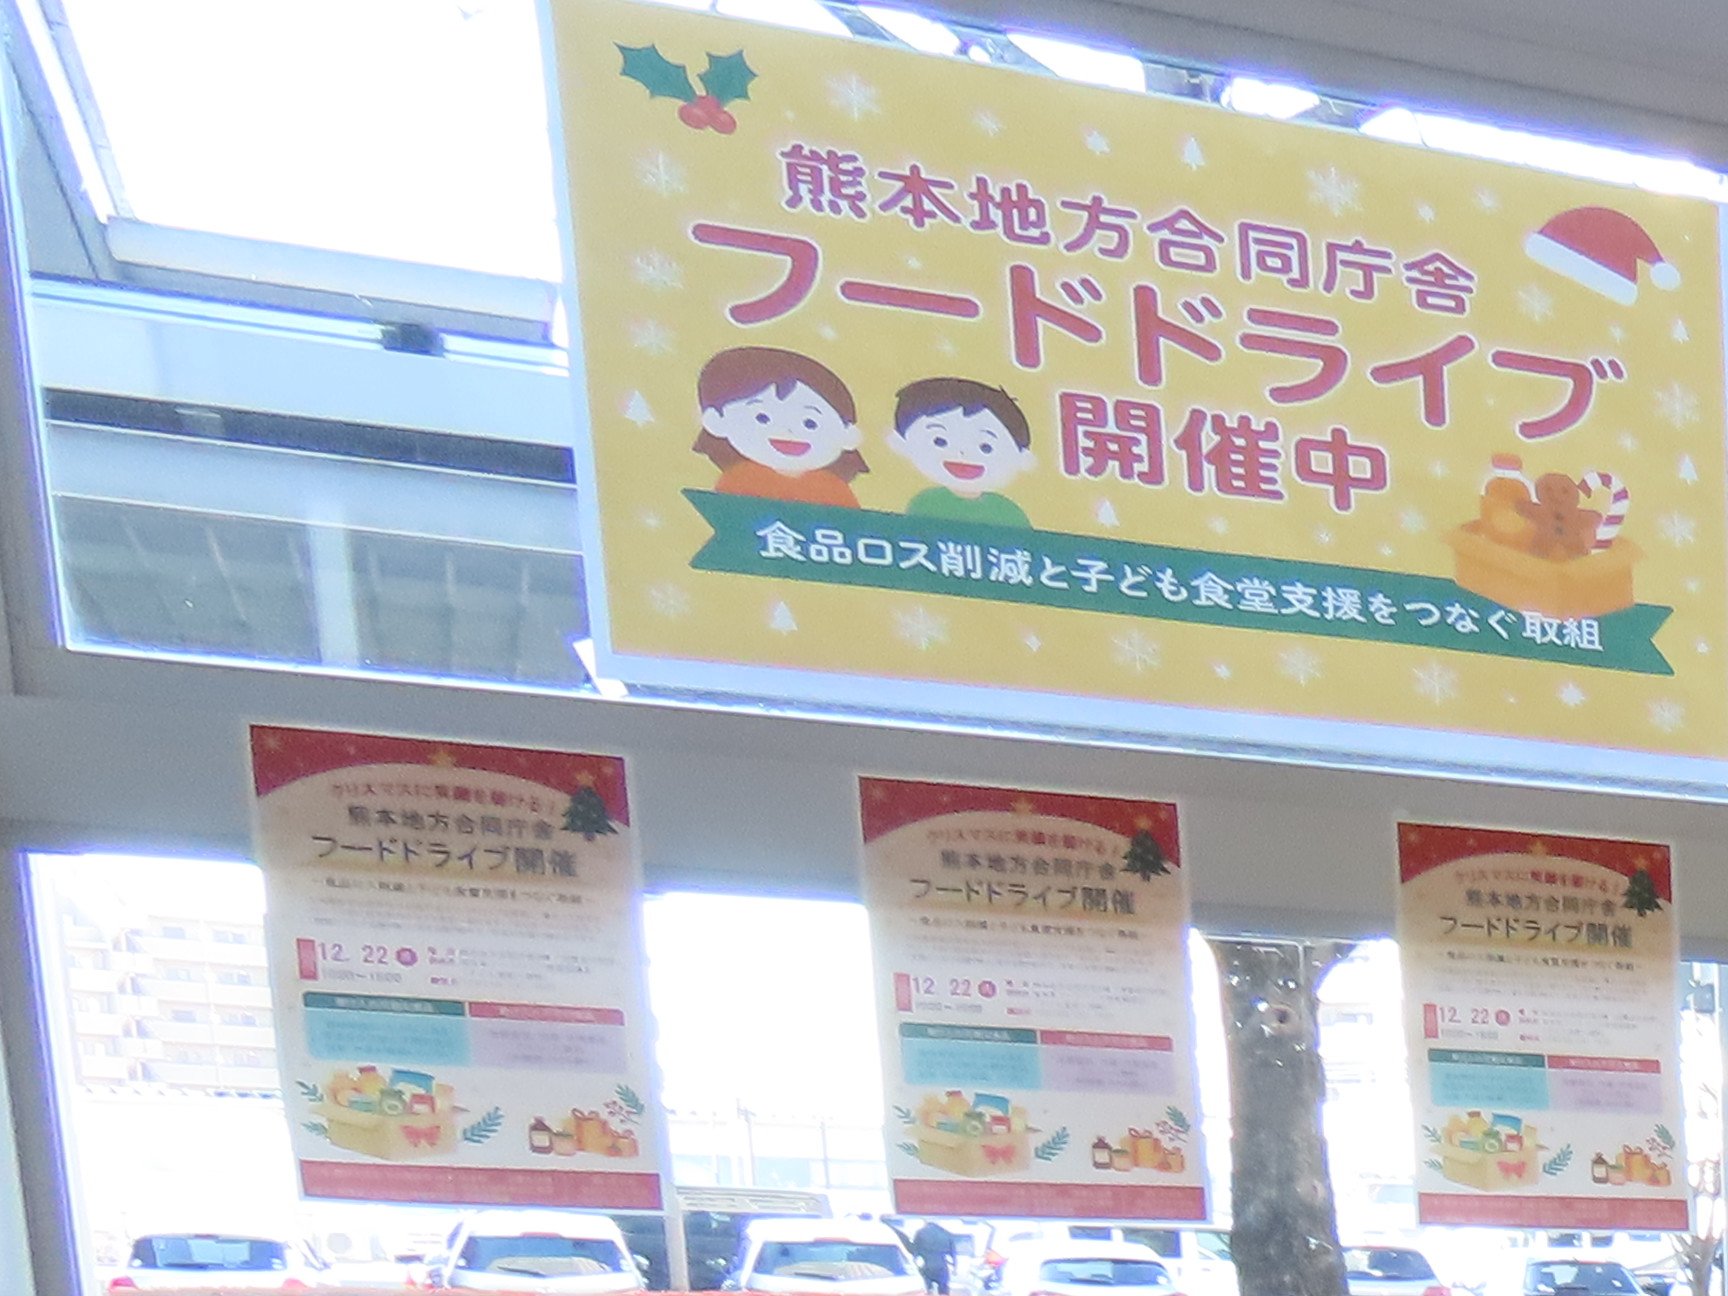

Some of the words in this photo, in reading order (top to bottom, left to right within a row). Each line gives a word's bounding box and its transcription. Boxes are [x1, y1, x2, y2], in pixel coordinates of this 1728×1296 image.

[778, 143, 1478, 316] 熊本地方合同庁舎
[690, 221, 1628, 441] フードドライブ
[1056, 391, 1390, 513] 開催中
[755, 519, 1604, 655] 食品ロス削減と子ども食堂支援をつなぐ取組
[311, 836, 579, 878] フードドライブ開催
[910, 879, 1135, 915] フードドライブ開催
[1440, 916, 1633, 949] フードドライブ開催
